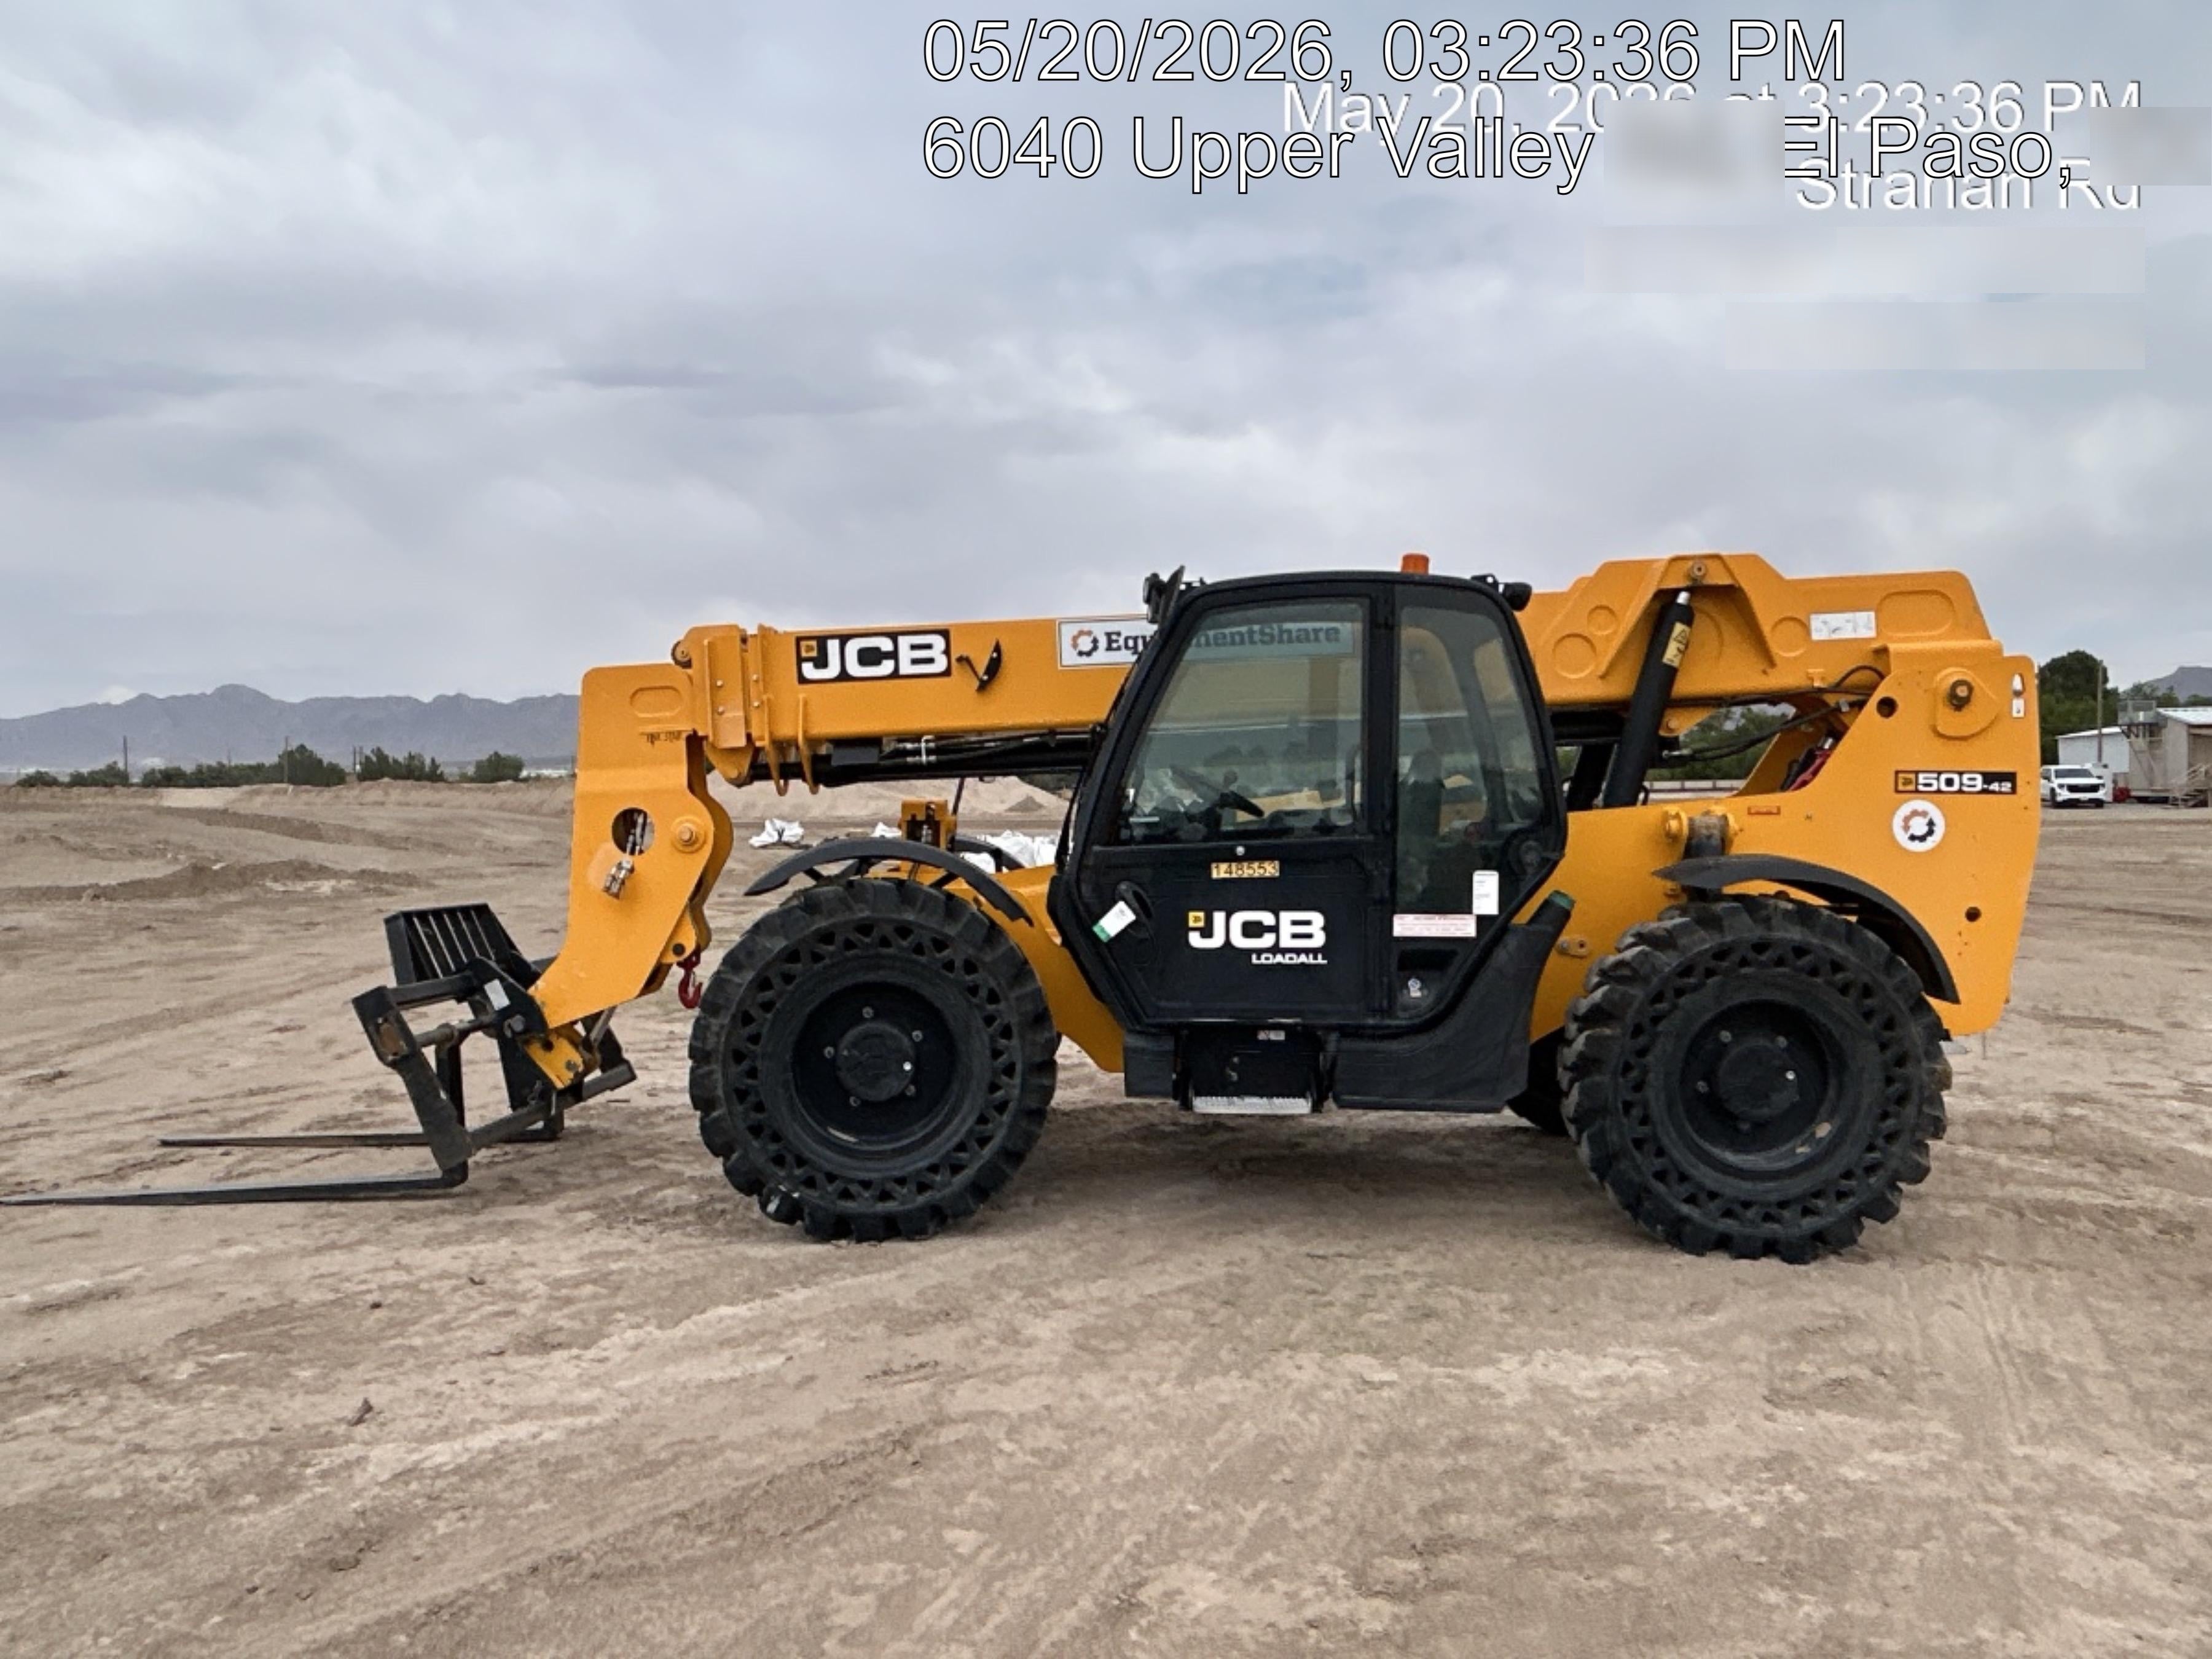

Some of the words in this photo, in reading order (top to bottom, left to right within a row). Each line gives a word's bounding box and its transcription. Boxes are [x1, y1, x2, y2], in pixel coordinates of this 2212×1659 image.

[801, 633, 948, 680] JCB
[1917, 772, 2012, 793] 509-42
[1212, 861, 1279, 877] 148553
[1188, 910, 1327, 949] JCB
[1251, 953, 1328, 964] LOADALL
